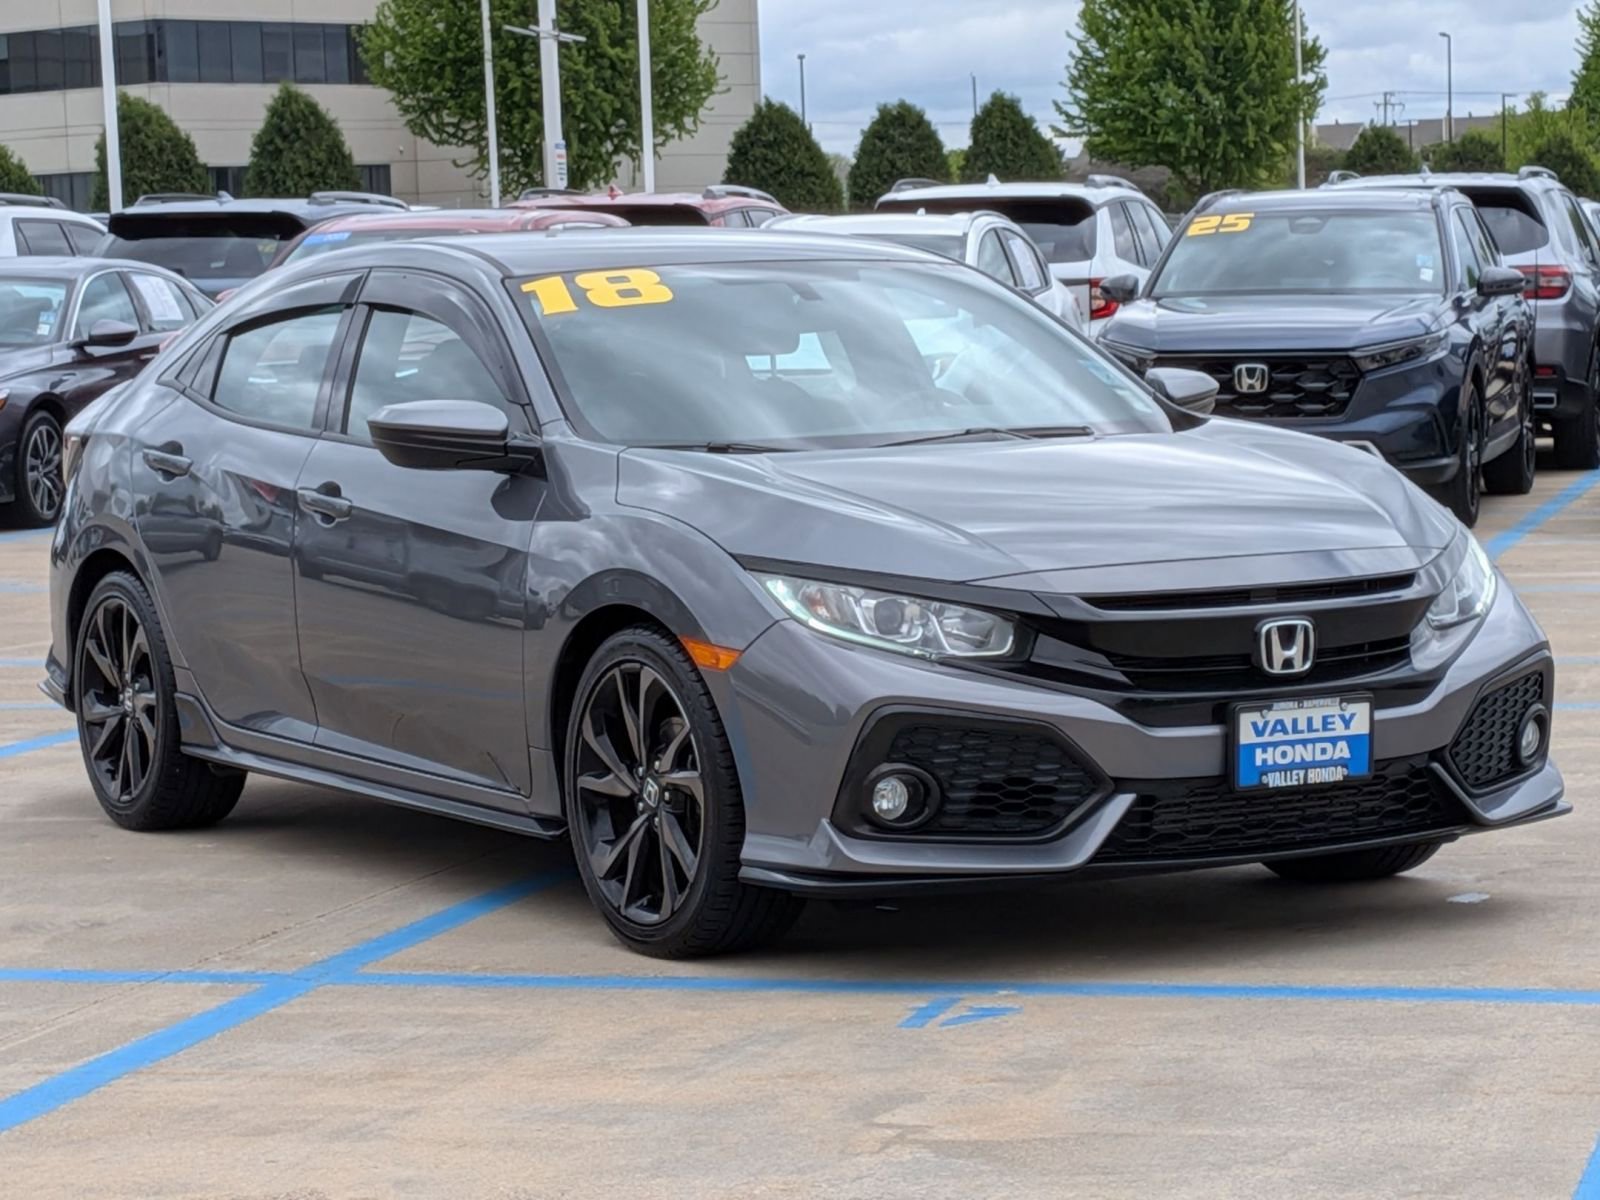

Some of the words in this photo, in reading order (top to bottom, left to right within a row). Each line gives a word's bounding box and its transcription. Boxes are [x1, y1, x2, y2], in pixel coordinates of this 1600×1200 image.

[1187, 213, 1255, 237] 25
[520, 269, 674, 315] 18
[1250, 712, 1357, 738] VALLEY
[1255, 741, 1351, 767] HONDA
[1268, 769, 1306, 788] VALLEY
[1307, 766, 1344, 784] HONDA
